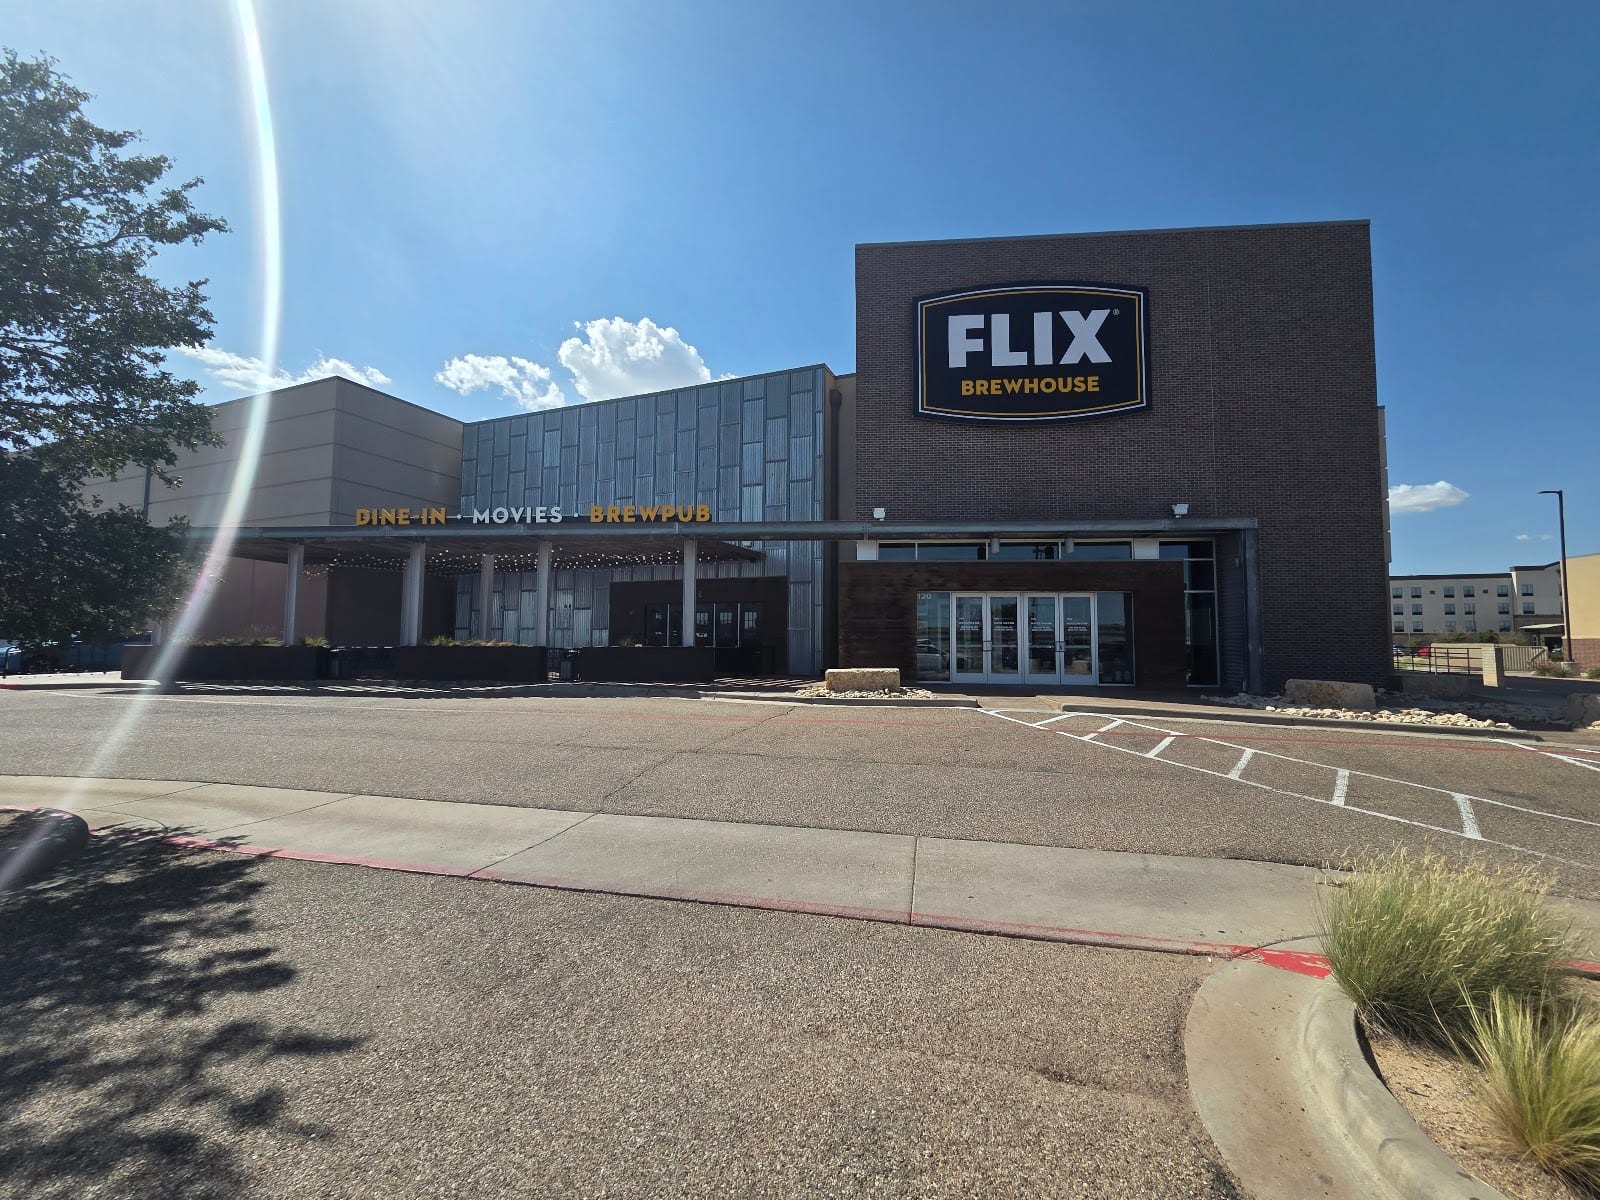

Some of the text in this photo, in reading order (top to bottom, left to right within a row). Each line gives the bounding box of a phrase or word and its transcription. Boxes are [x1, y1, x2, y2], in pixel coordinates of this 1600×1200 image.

[947, 309, 1113, 369] FLIX
[961, 375, 1100, 396] BREWHOUSE
[356, 504, 711, 526] DINE-IN MOVIES BREWPUB
